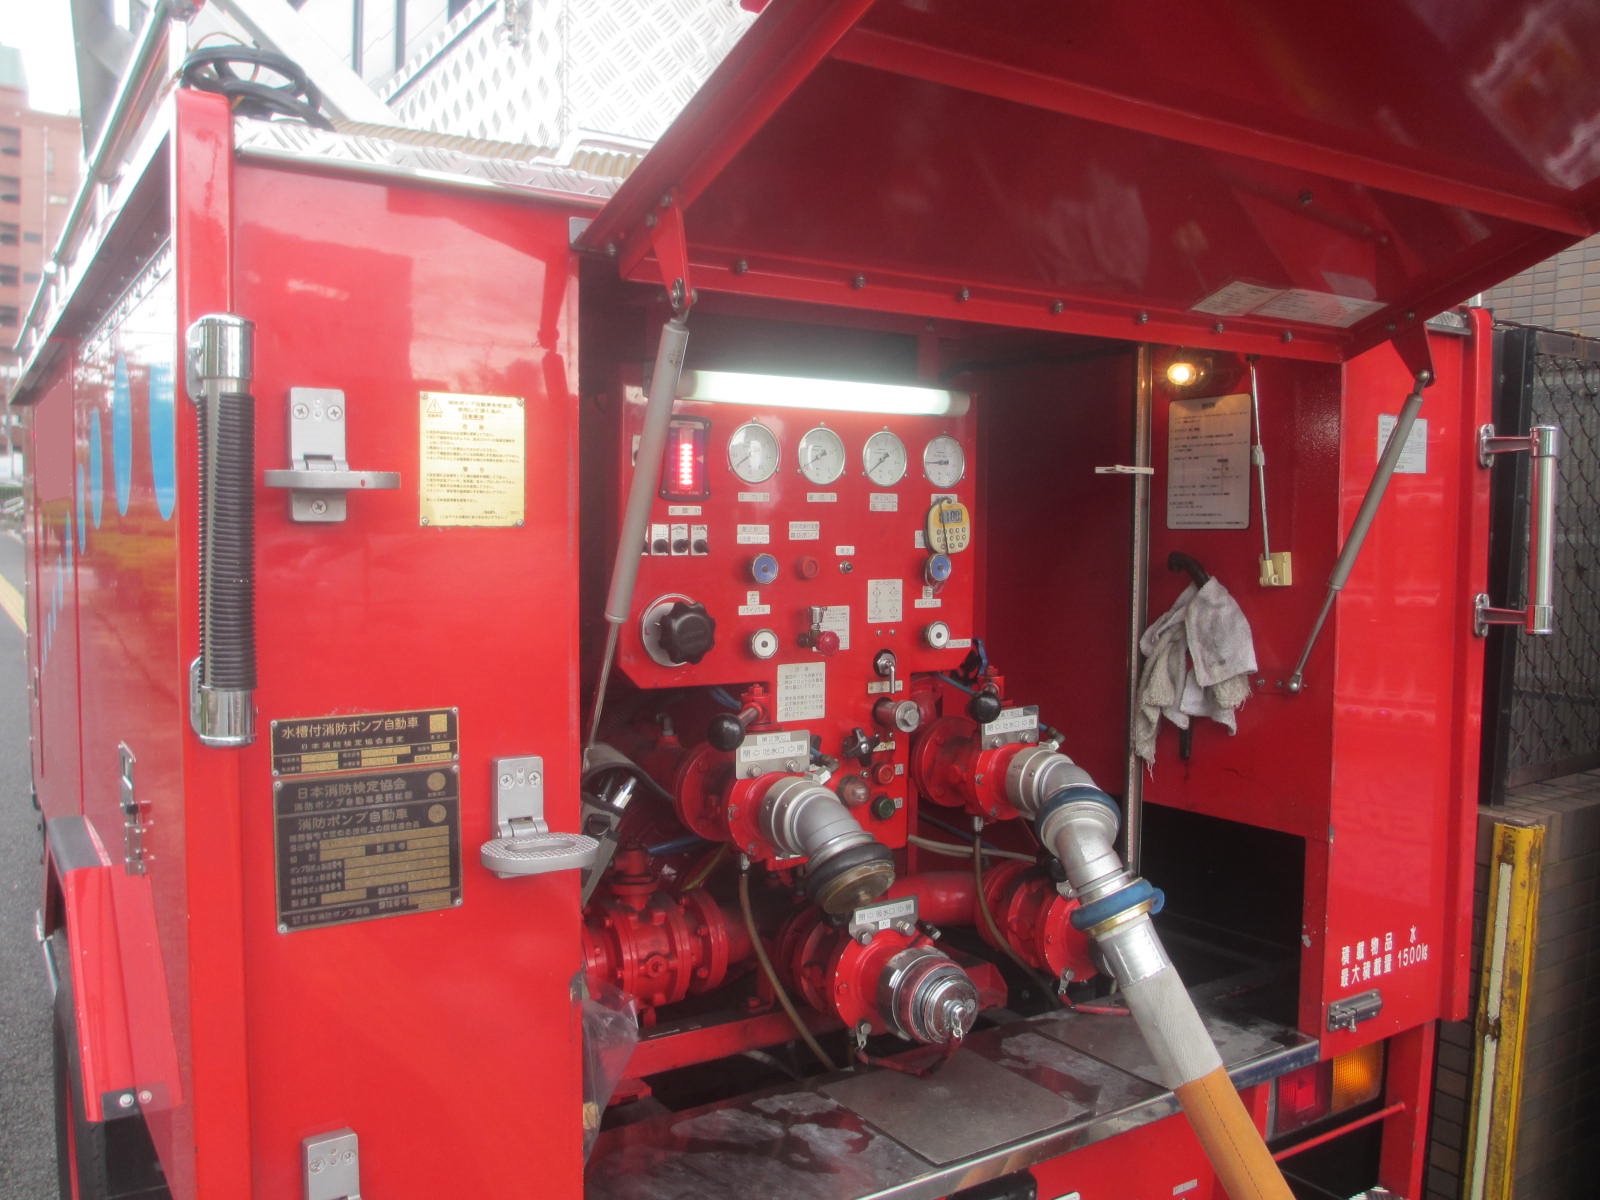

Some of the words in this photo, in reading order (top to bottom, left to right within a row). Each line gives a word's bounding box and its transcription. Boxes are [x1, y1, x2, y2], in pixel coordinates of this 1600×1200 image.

[281, 716, 419, 740] 水槽付消防ポンプ自動車
[297, 777, 407, 800] 日本消防検定協会
[298, 808, 409, 831] 消防ポンプ自動車
[1340, 953, 1392, 988] 最大積載量
